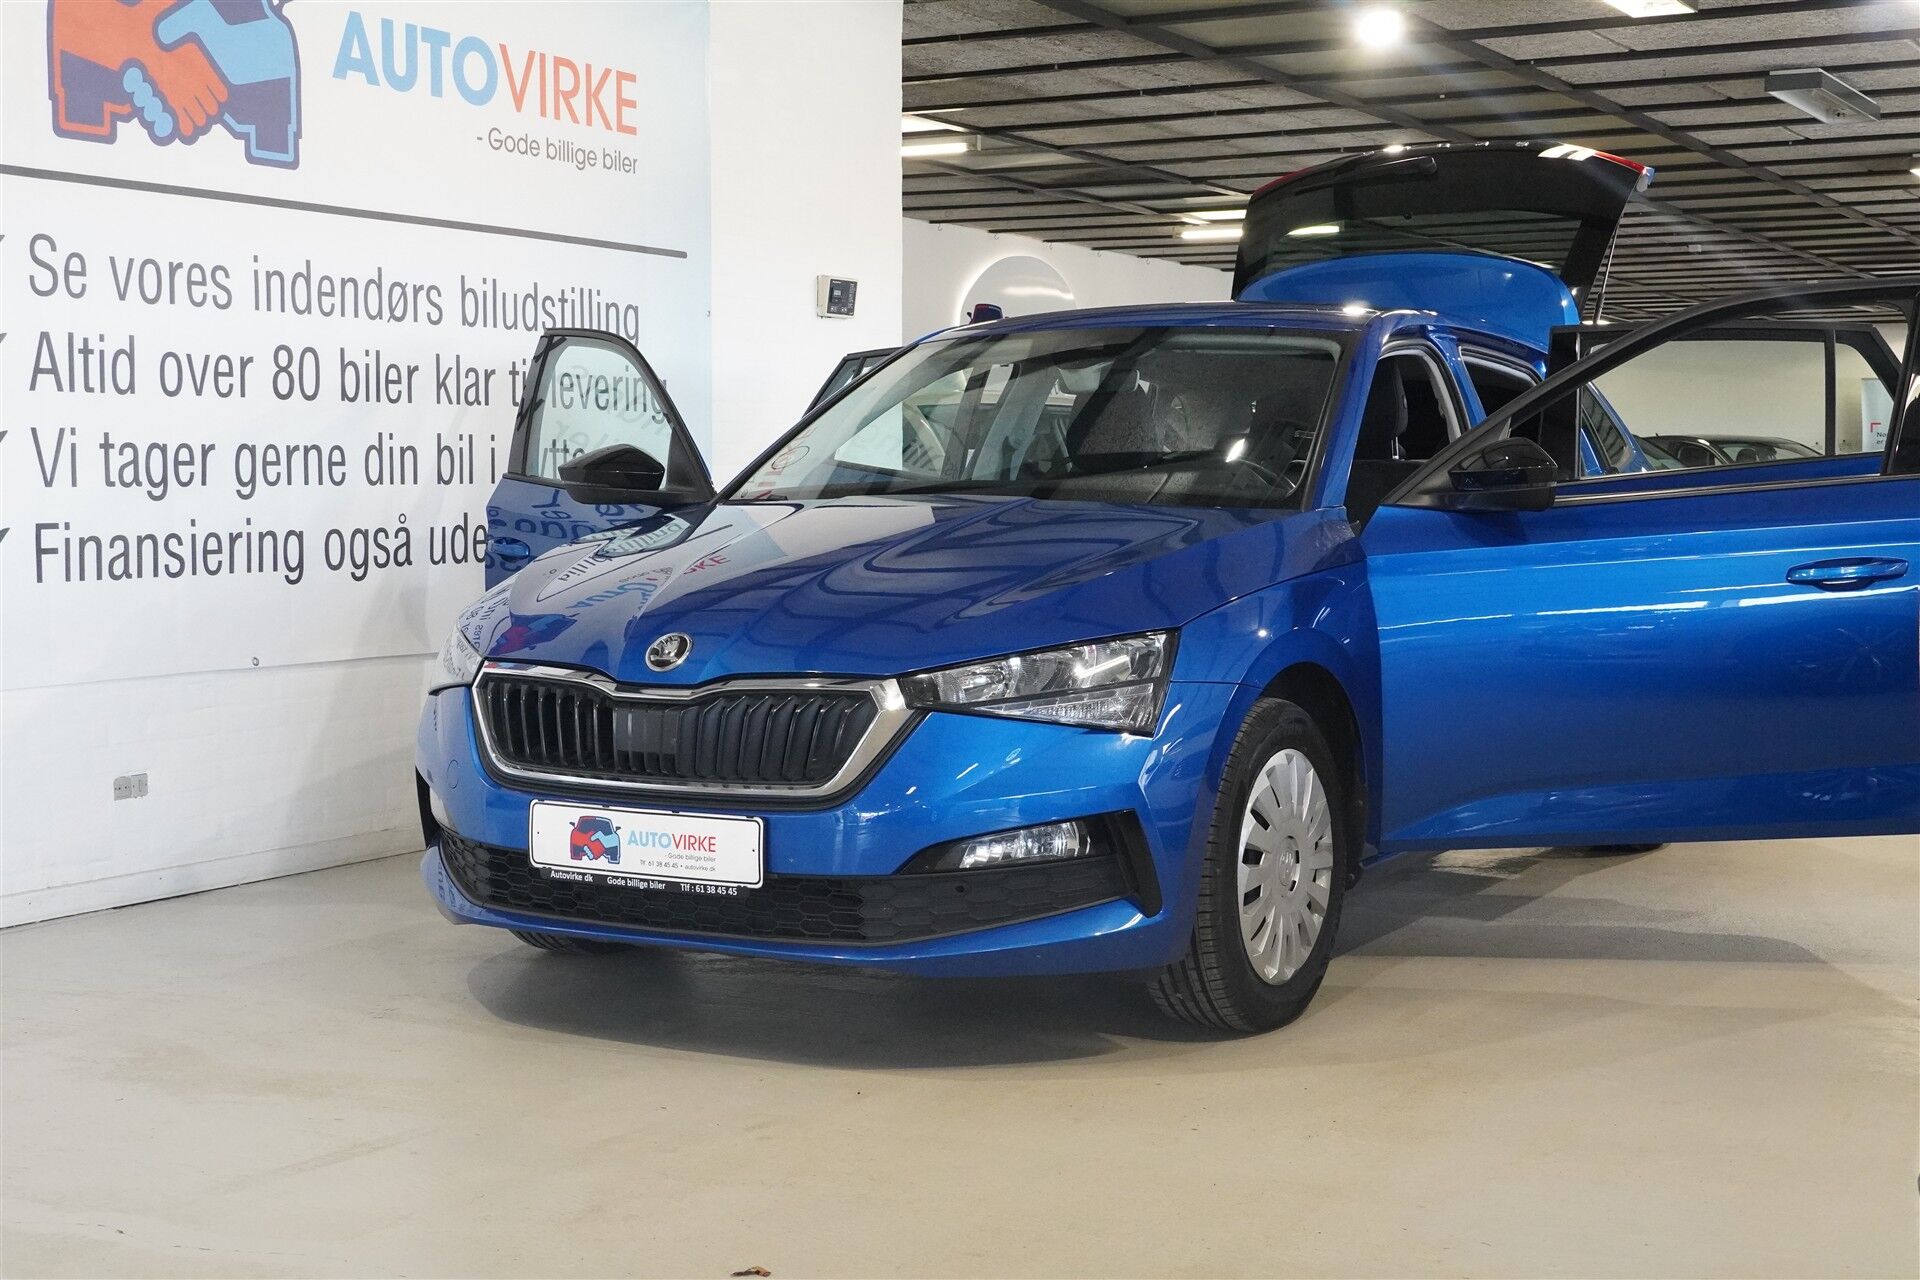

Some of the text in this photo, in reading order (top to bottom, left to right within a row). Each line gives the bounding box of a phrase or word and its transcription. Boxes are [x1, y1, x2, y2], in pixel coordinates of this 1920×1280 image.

[333, 11, 637, 136] AUTOVIRKE
[488, 127, 540, 157] Gode
[546, 136, 597, 171] billige
[602, 147, 638, 175] biler
[29, 233, 640, 348] Se vores indendørs biludstilling
[29, 331, 136, 396] Altid
[159, 351, 255, 399] over
[272, 343, 321, 402] 80
[339, 346, 420, 405] biler
[435, 352, 497, 407] klar
[508, 357, 529, 408] ti
[30, 426, 78, 488] Vi
[99, 431, 216, 502] tager
[234, 442, 347, 501] gerne
[364, 431, 419, 487] din
[436, 432, 474, 486] bil
[490, 433, 496, 484] i
[34, 517, 305, 586] Finansiering
[324, 513, 413, 583] også
[627, 829, 717, 853] AUTOVIRKE
[668, 852, 685, 861] Gode
[685, 854, 702, 863] billige
[606, 876, 666, 890] Gode billige biler
[695, 884, 705, 893] 61
[706, 885, 716, 894] 38
[717, 886, 727, 895] 45
[727, 887, 738, 896] 45
